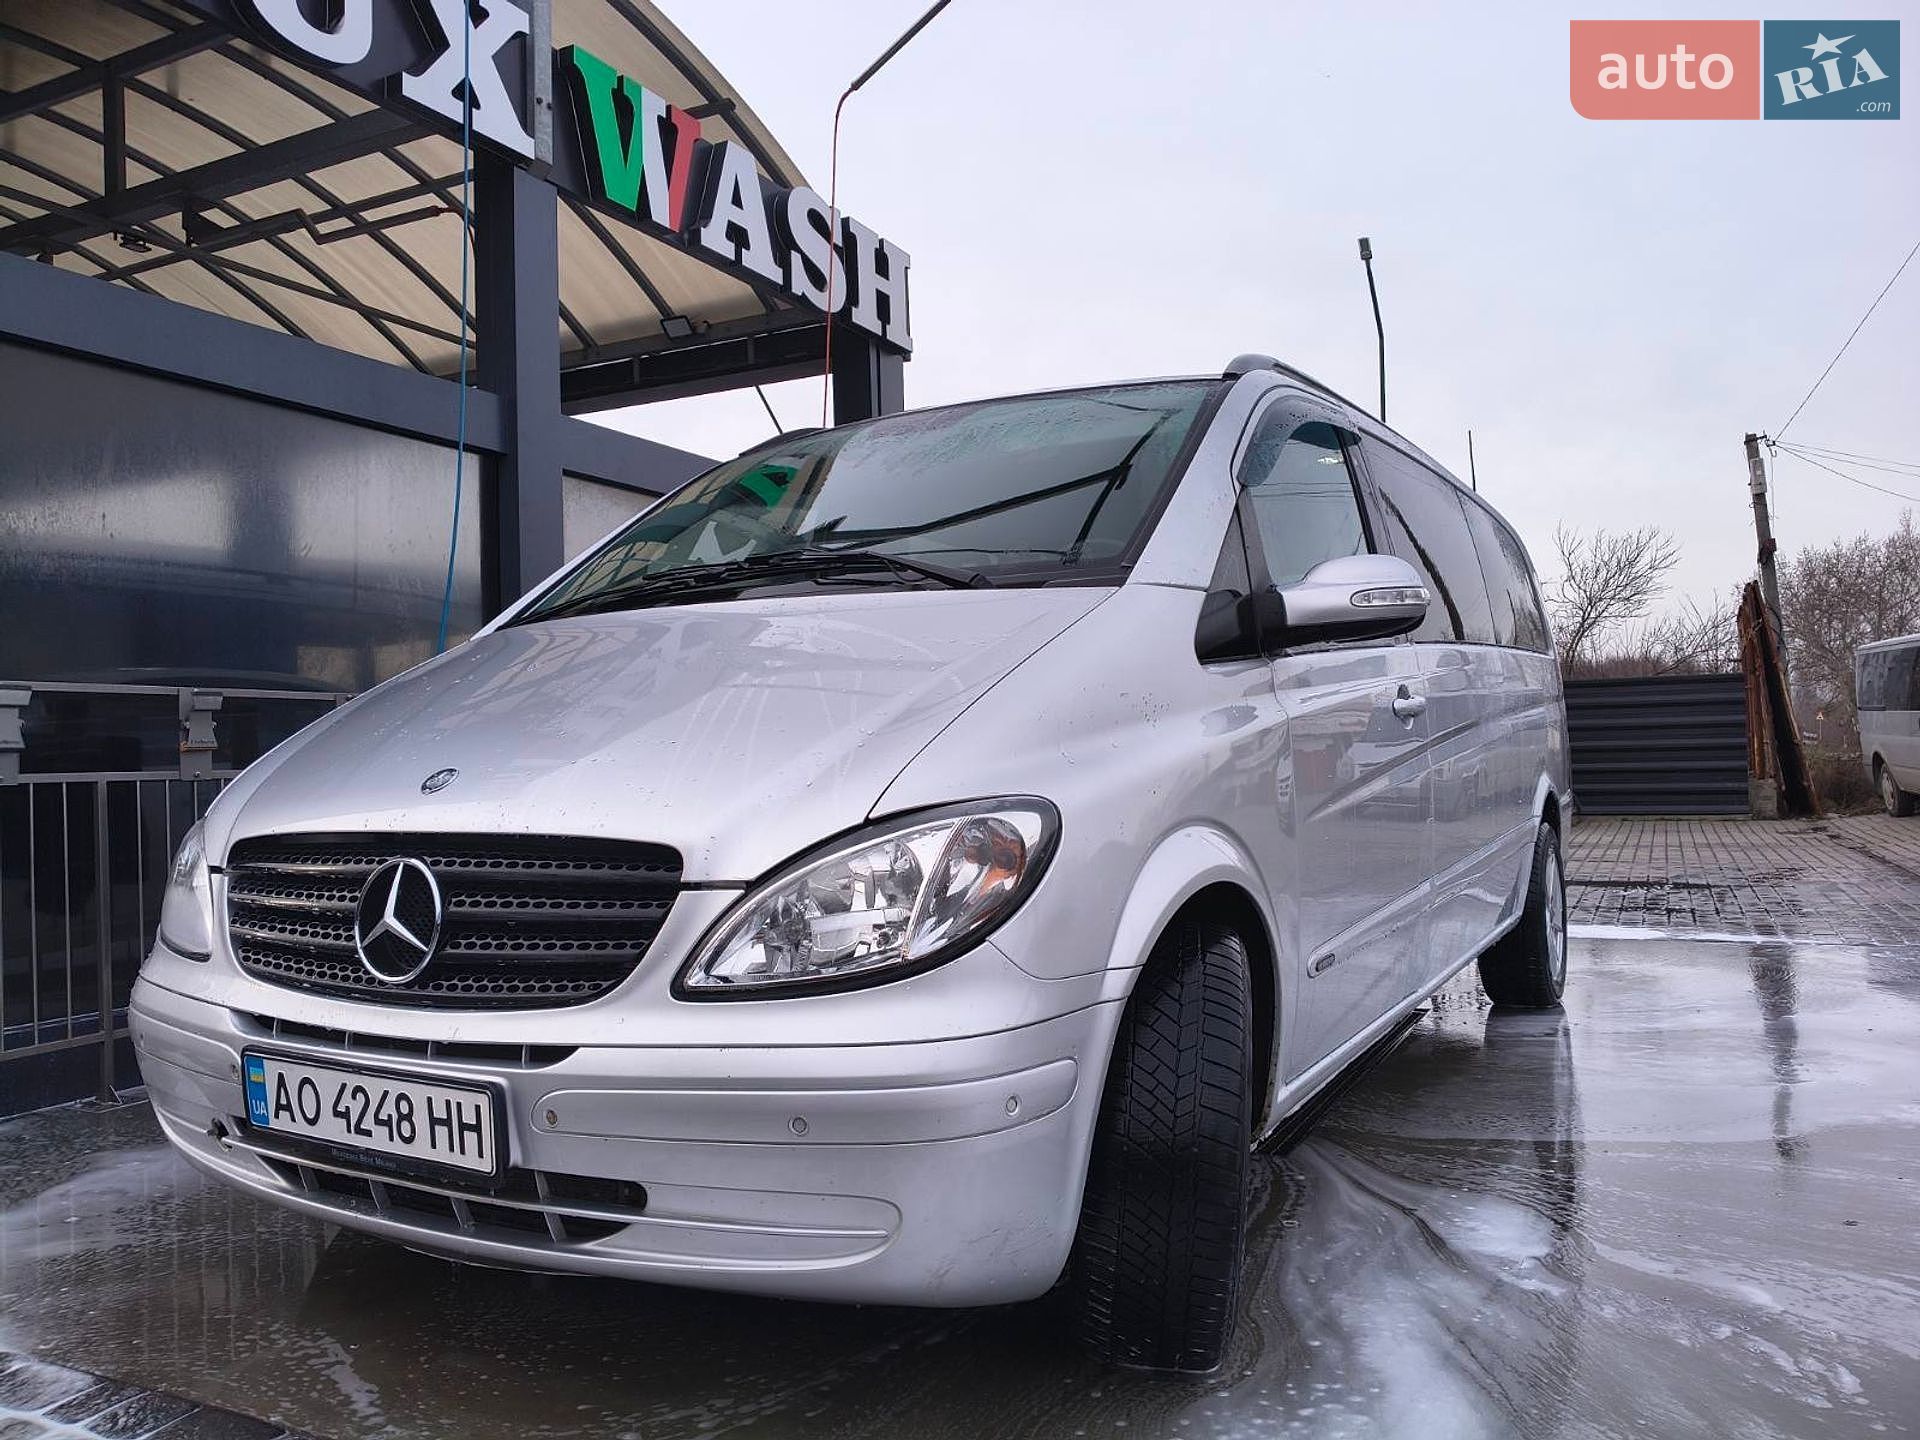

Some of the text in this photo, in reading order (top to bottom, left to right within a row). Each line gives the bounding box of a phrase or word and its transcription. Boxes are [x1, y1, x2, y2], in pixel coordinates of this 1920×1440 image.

[573, 44, 913, 353] WASH
[251, 1100, 268, 1117] UA
[273, 1071, 485, 1159] AO 4248 HH
